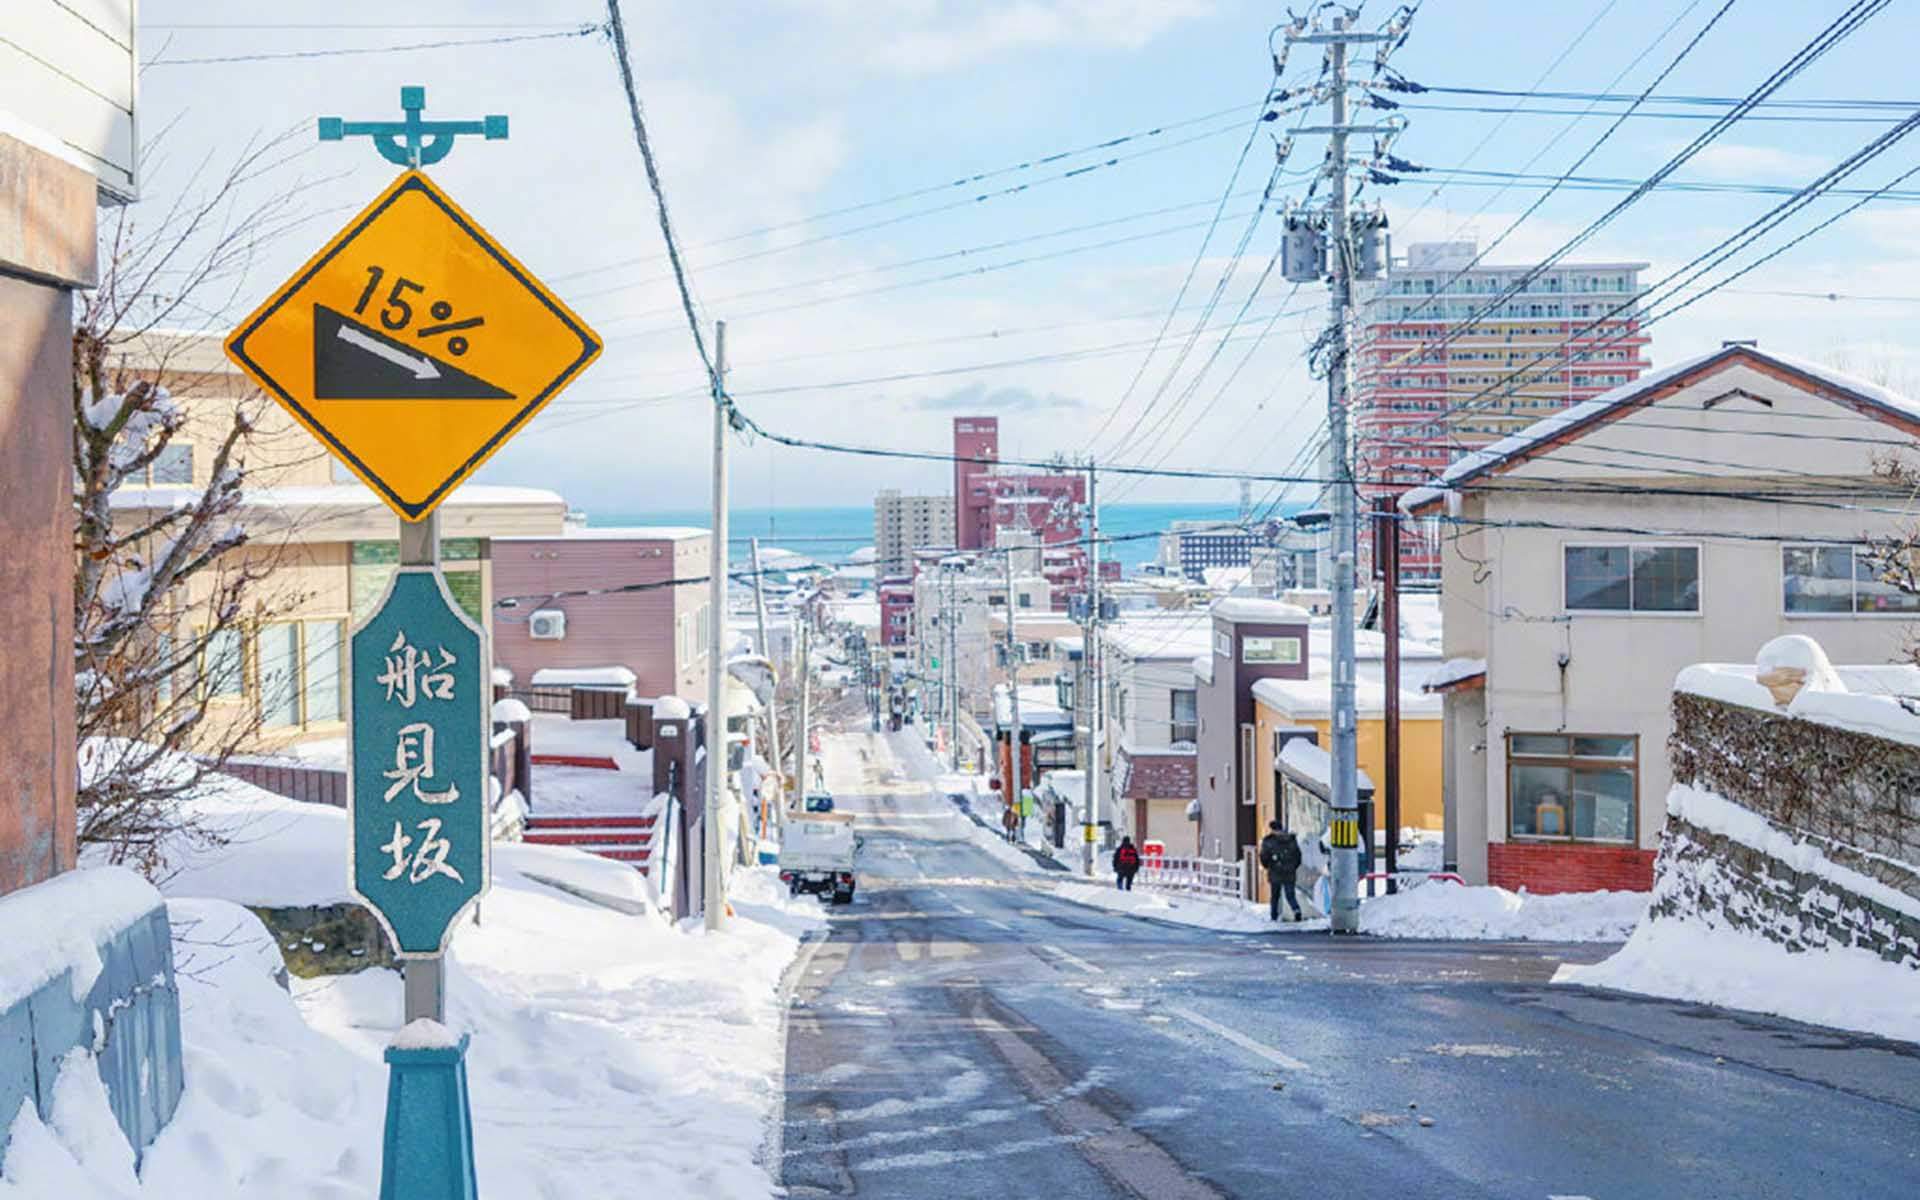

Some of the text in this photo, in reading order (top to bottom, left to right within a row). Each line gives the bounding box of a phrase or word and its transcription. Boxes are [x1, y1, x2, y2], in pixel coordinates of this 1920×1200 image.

[353, 266, 485, 357] 15%
[377, 631, 464, 884] 船見坂
